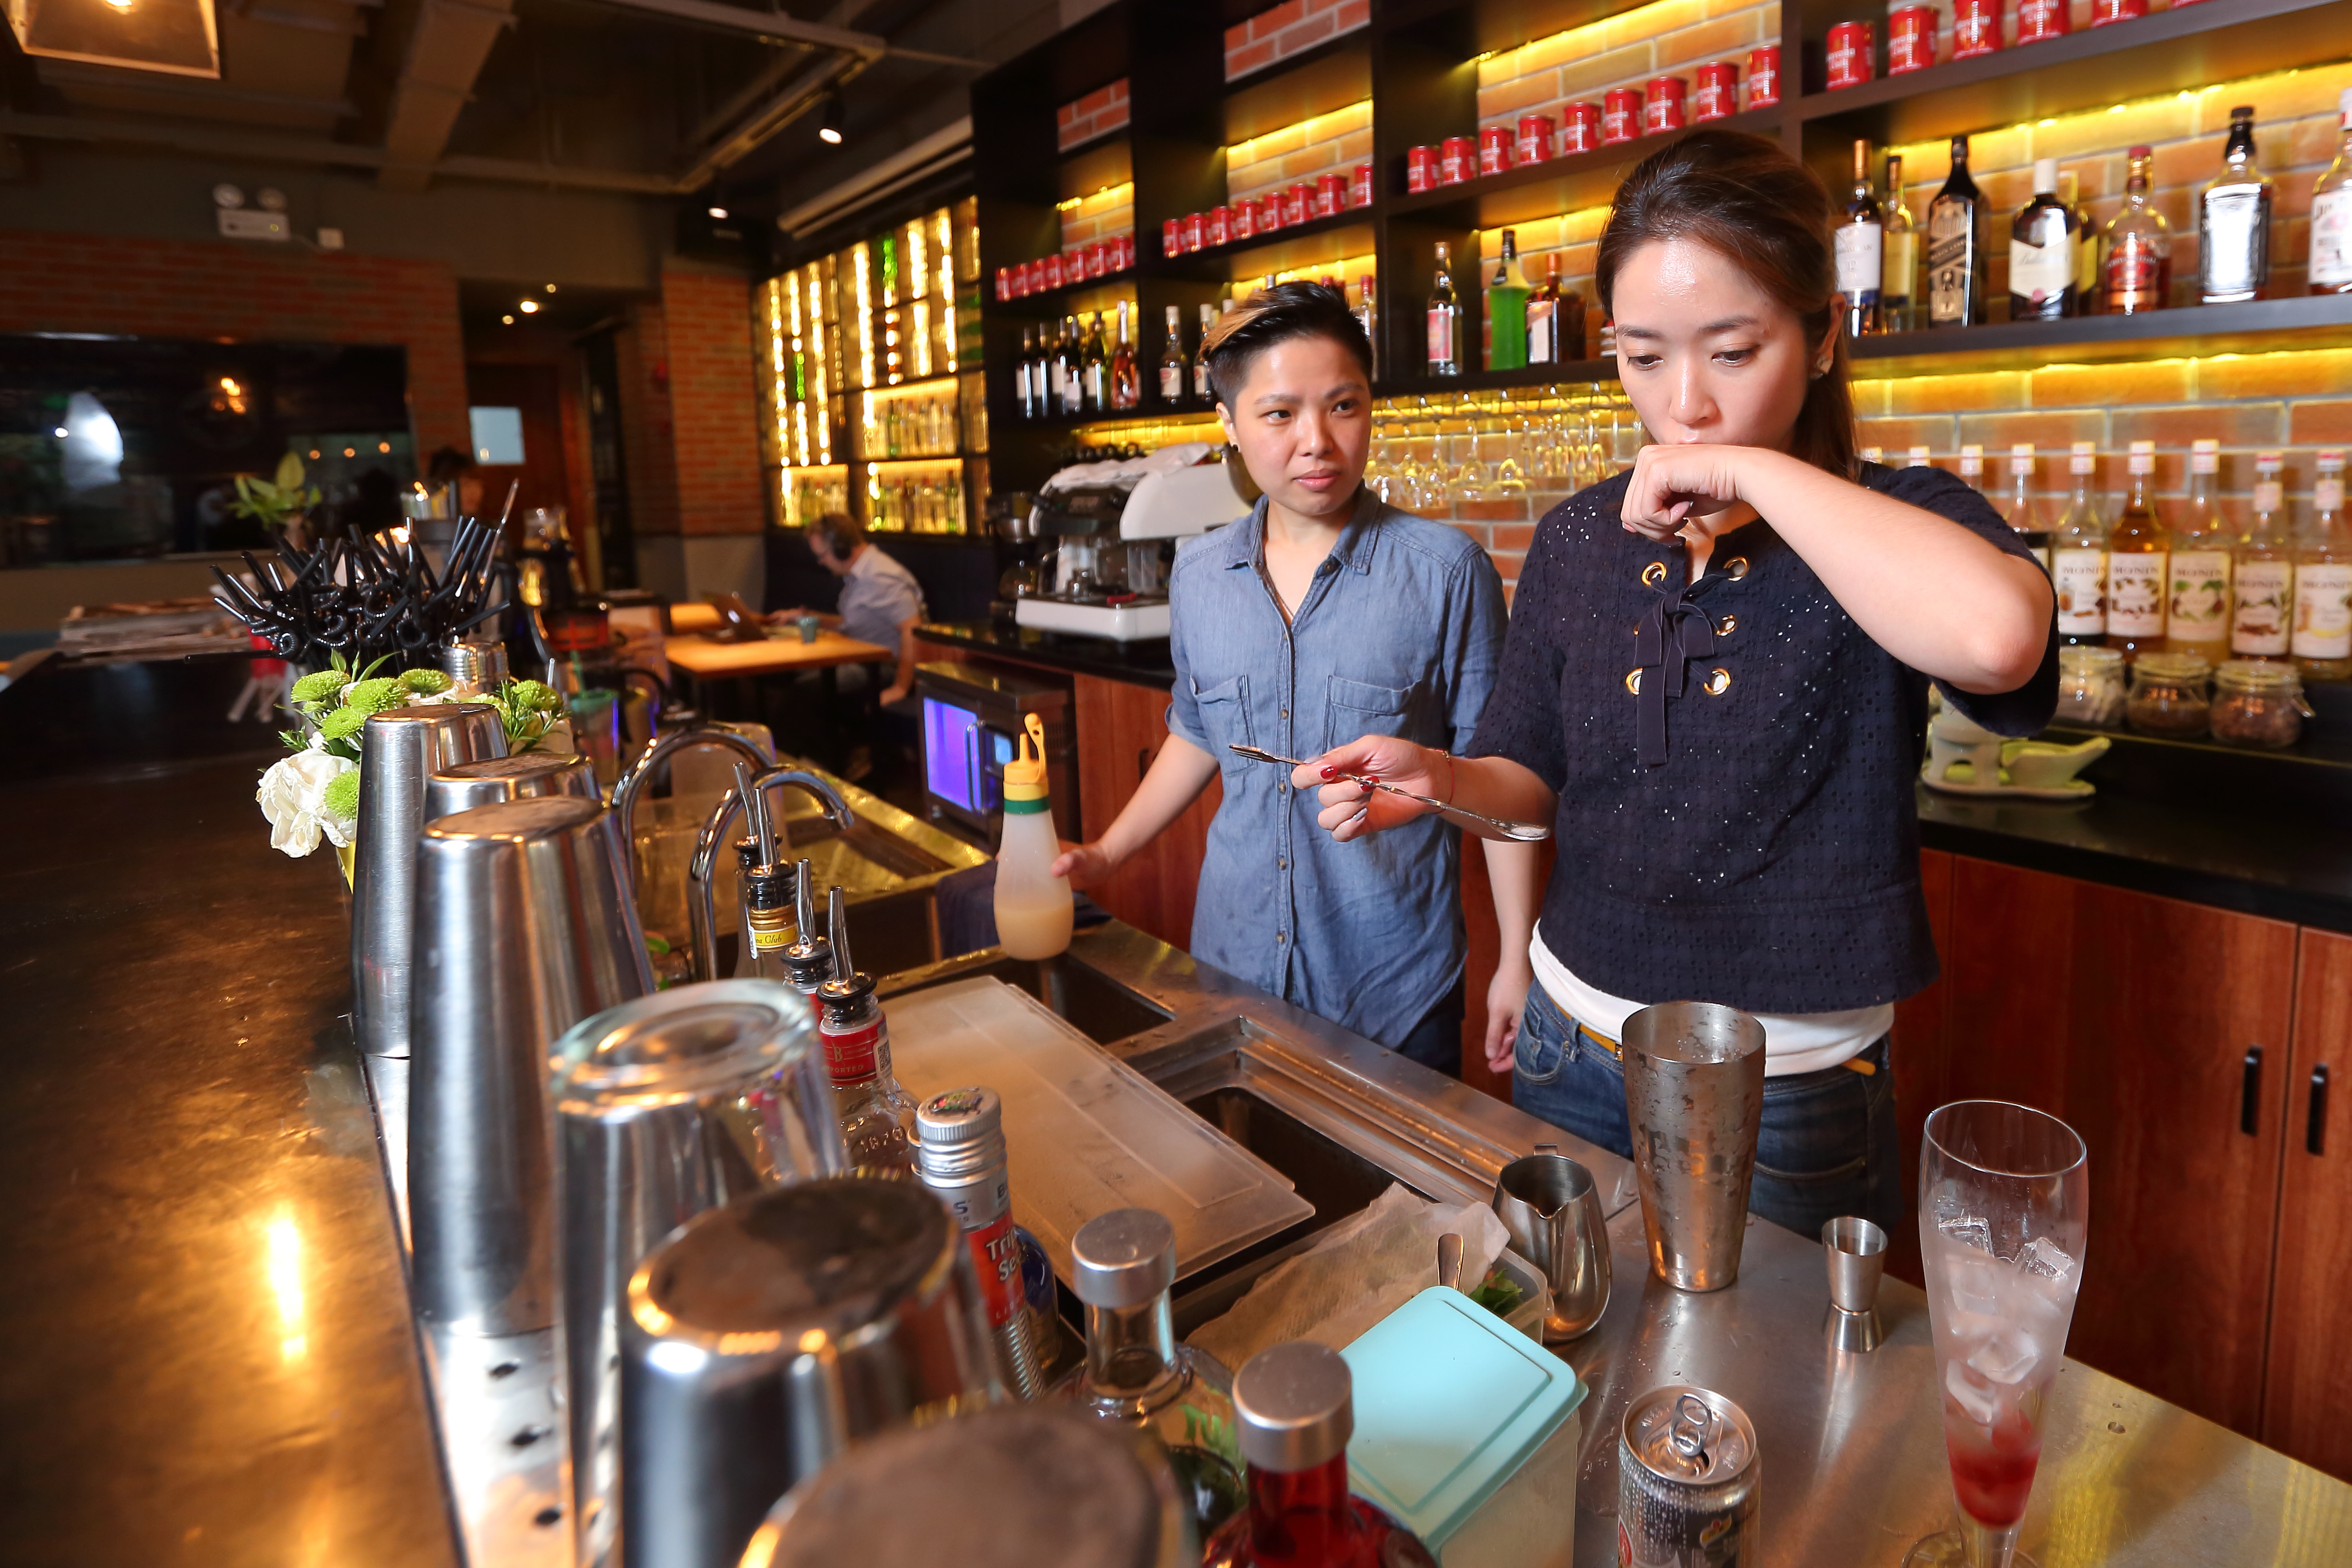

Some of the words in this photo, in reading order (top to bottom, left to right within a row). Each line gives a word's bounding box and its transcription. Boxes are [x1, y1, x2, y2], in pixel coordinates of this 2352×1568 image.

[764, 933, 782, 944] Club
[834, 1046, 843, 1062] B
[845, 1046, 867, 1055] LONDON
[826, 1065, 864, 1073] PORTED
[986, 1227, 1017, 1261] Trip
